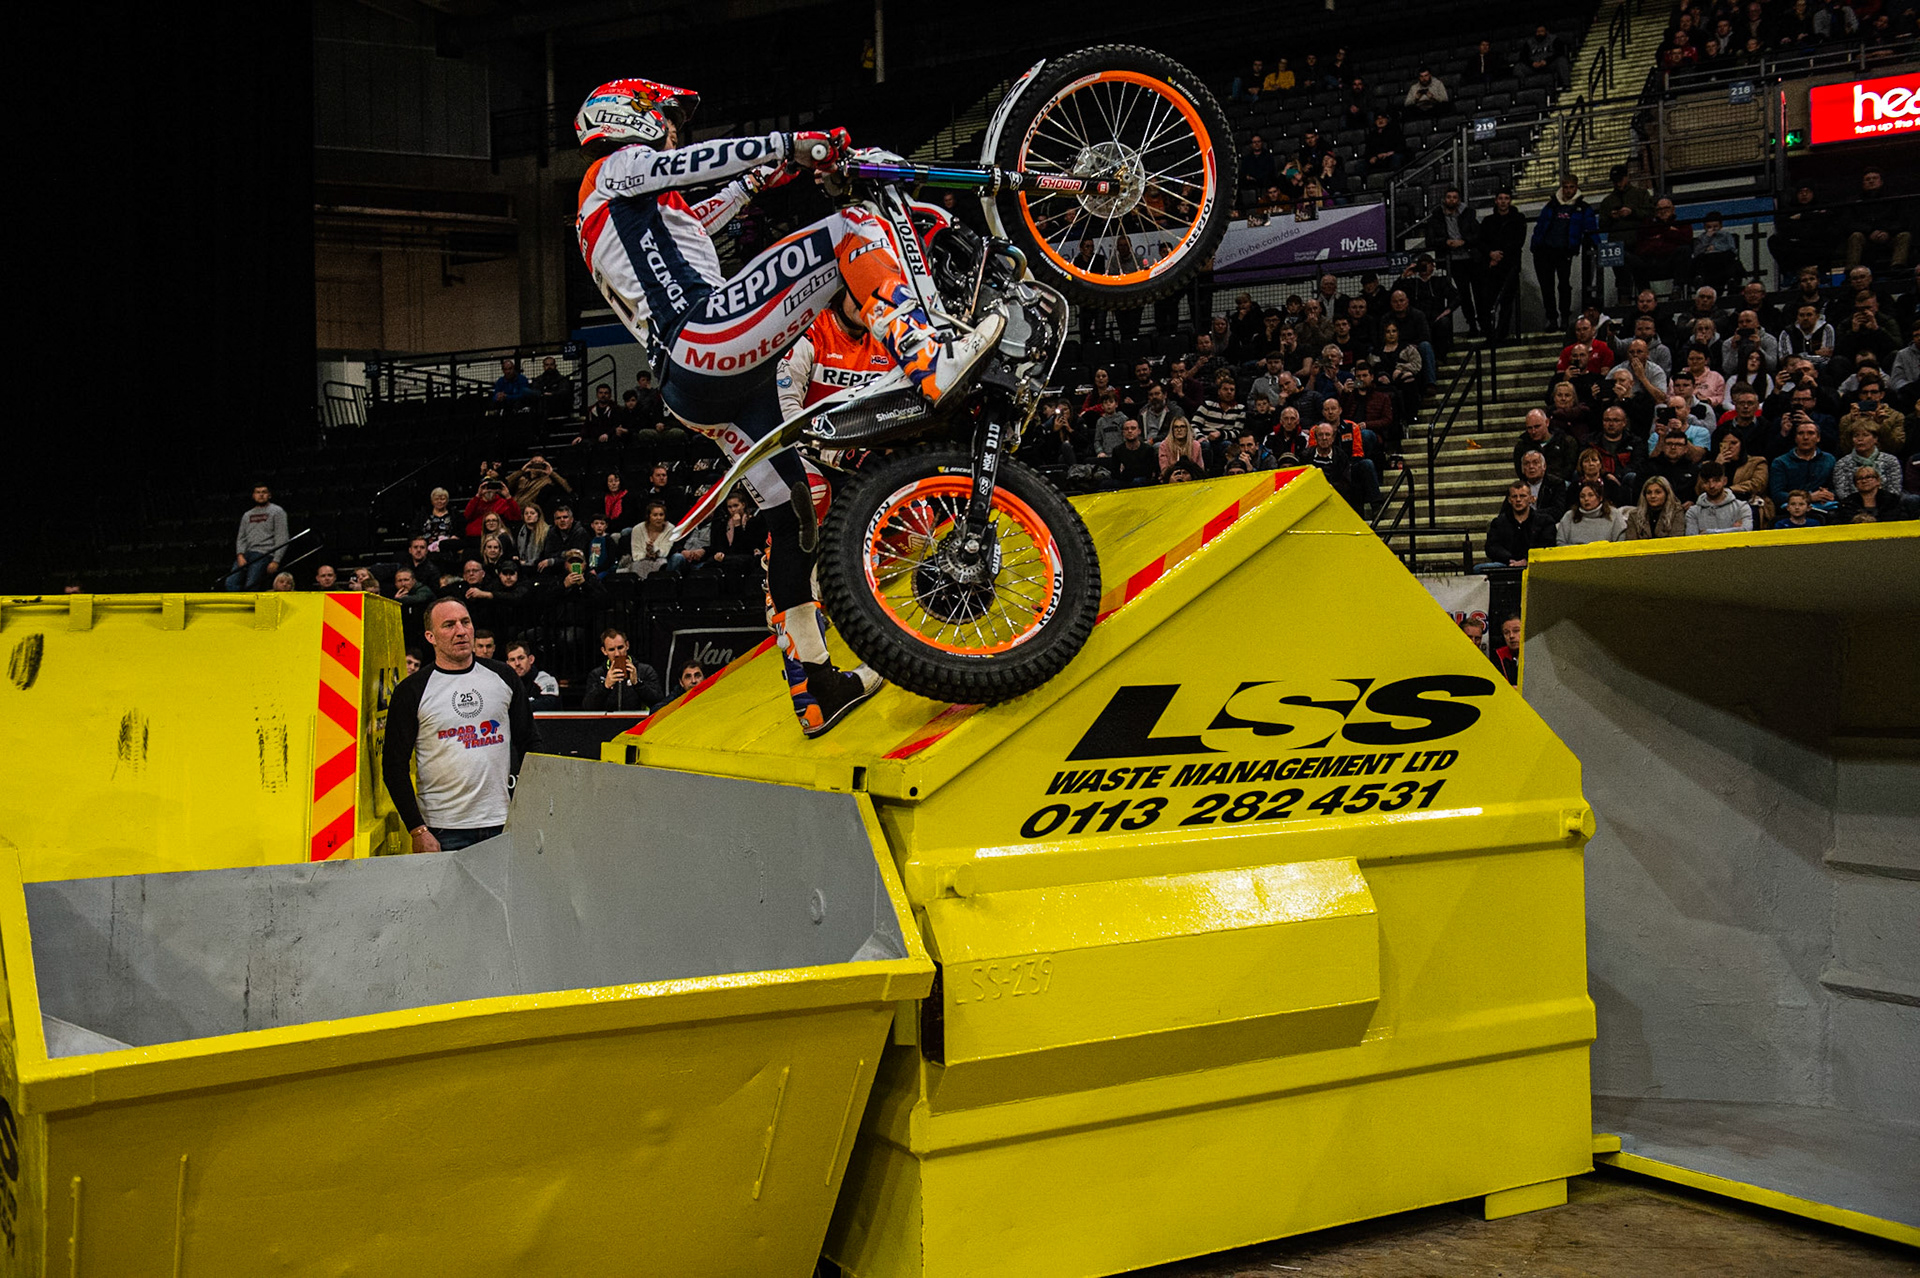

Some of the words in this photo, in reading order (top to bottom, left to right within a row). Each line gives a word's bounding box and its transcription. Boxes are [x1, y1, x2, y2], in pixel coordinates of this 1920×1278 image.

[1731, 86, 1751, 96] 218
[1476, 122, 1494, 132] 219
[1877, 122, 1893, 132] up
[605, 174, 644, 190] hebo
[1041, 179, 1082, 190] SHOWA
[1185, 197, 1214, 249] REPSOL
[897, 219, 926, 276] REPSOL
[1601, 247, 1621, 257] 118
[1391, 257, 1409, 266] 119
[705, 237, 823, 319] REPSOL
[783, 266, 837, 317] hebo
[685, 307, 815, 371] Montesa
[564, 345, 577, 353] 120
[875, 404, 922, 423] ShinDengen
[982, 452, 993, 471] NGK
[991, 543, 1001, 575] GALFER
[1038, 570, 1063, 626] REPSOL
[460, 692, 473, 703] 25
[1065, 674, 1496, 762] LSS
[438, 725, 476, 740] ROAD
[457, 733, 478, 741] AND
[463, 734, 504, 749] TRIALS
[1044, 765, 1171, 796] WASTE
[1170, 752, 1405, 788] MANAGEMENT
[1402, 749, 1460, 774] LTD
[1019, 796, 1169, 840] 0113
[1177, 788, 1305, 828] 282
[1307, 779, 1448, 814] 4531
